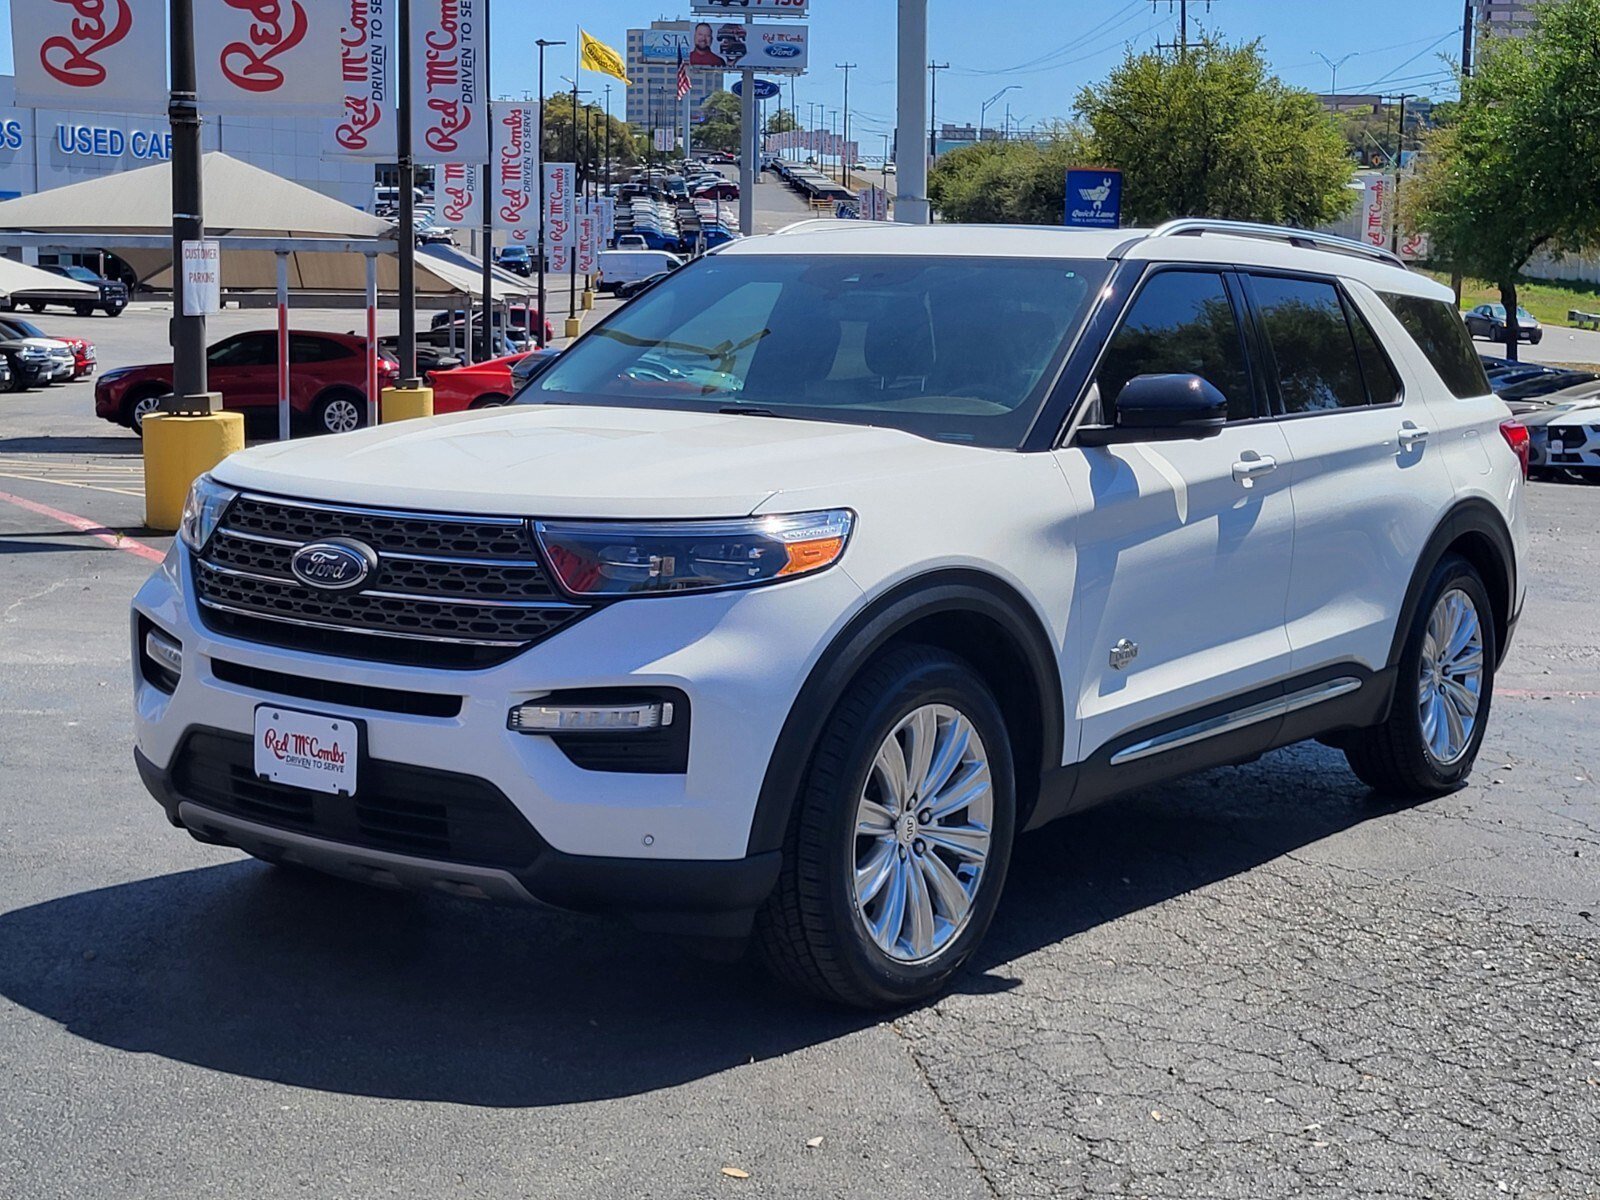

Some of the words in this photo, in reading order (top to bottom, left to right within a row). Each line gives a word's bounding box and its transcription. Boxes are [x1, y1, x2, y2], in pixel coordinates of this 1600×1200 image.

[371, 20, 382, 39] TO
[461, 22, 472, 42] TO
[762, 33, 775, 43] Red
[220, 0, 308, 92] Red
[771, 46, 794, 56] Ford
[372, 45, 383, 101] DRIVEN
[461, 48, 473, 103] DRIVEN
[335, 95, 381, 150] Red
[425, 99, 471, 152] Red
[523, 109, 532, 139] SERVE
[59, 125, 124, 156] USED
[501, 109, 523, 186] McCombs
[523, 140, 532, 154] TO
[523, 157, 533, 192] DRIVEN
[443, 187, 472, 222] Red
[499, 189, 530, 223] Red
[550, 168, 564, 217] McCombs
[1368, 180, 1384, 228] McCombs
[1071, 209, 1095, 218] Quick
[1095, 210, 1116, 218] Lane
[549, 220, 568, 242] Red
[184, 248, 218, 260] CUSTOMER
[553, 254, 566, 271] Red
[580, 256, 593, 271] Red
[188, 272, 215, 283] PARKING
[305, 551, 348, 580] Ford
[264, 728, 289, 760] Red
[290, 734, 345, 765] McCombs
[285, 754, 312, 768] DRIVEN
[312, 759, 323, 769] TO
[324, 762, 345, 773] SERVE
